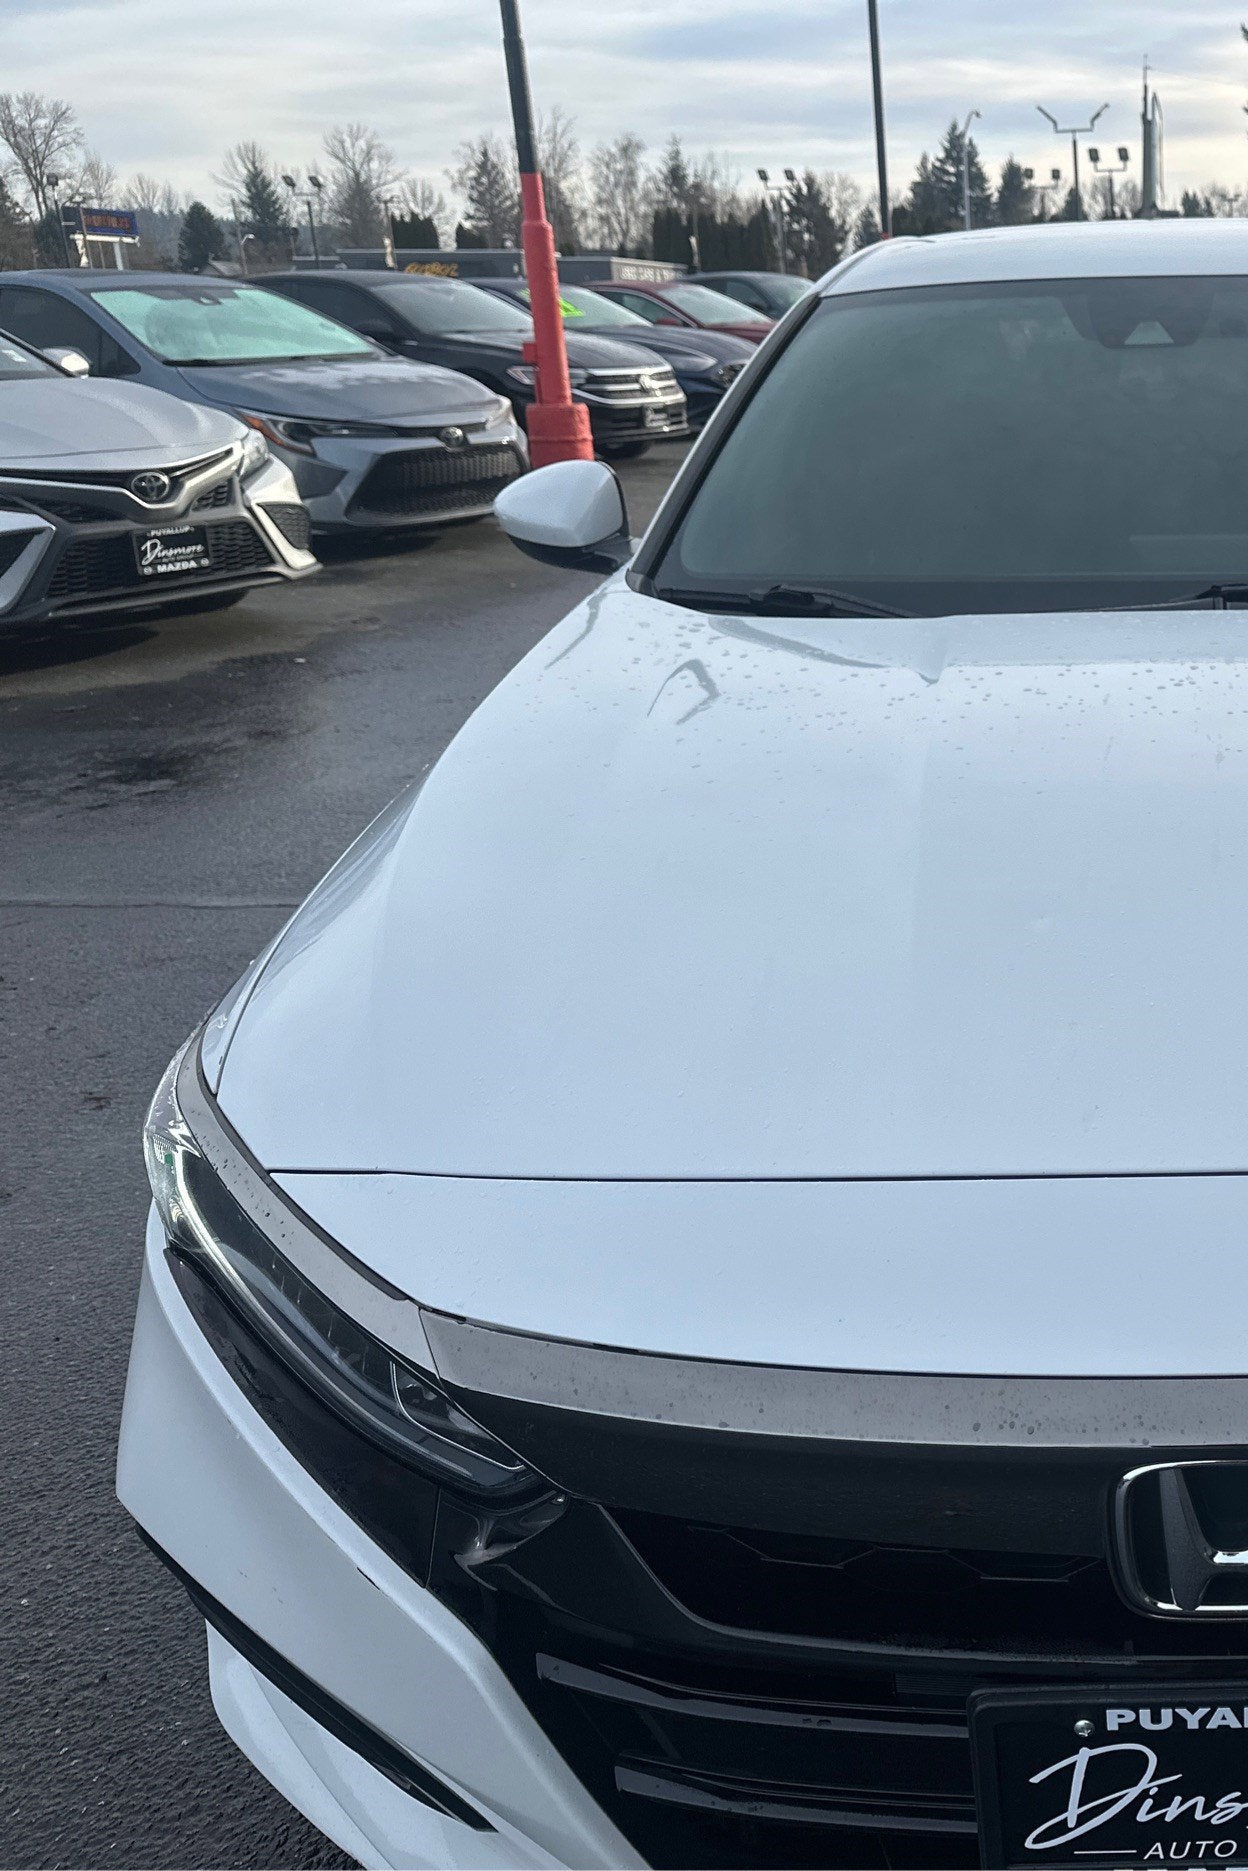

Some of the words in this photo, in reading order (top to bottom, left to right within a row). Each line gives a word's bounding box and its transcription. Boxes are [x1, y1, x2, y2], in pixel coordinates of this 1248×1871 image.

[150, 525, 191, 536] PUYALLUP
[141, 539, 204, 565] Dinsmore
[157, 560, 197, 573] MAZDA
[1143, 1839, 1238, 1860] AUTO
